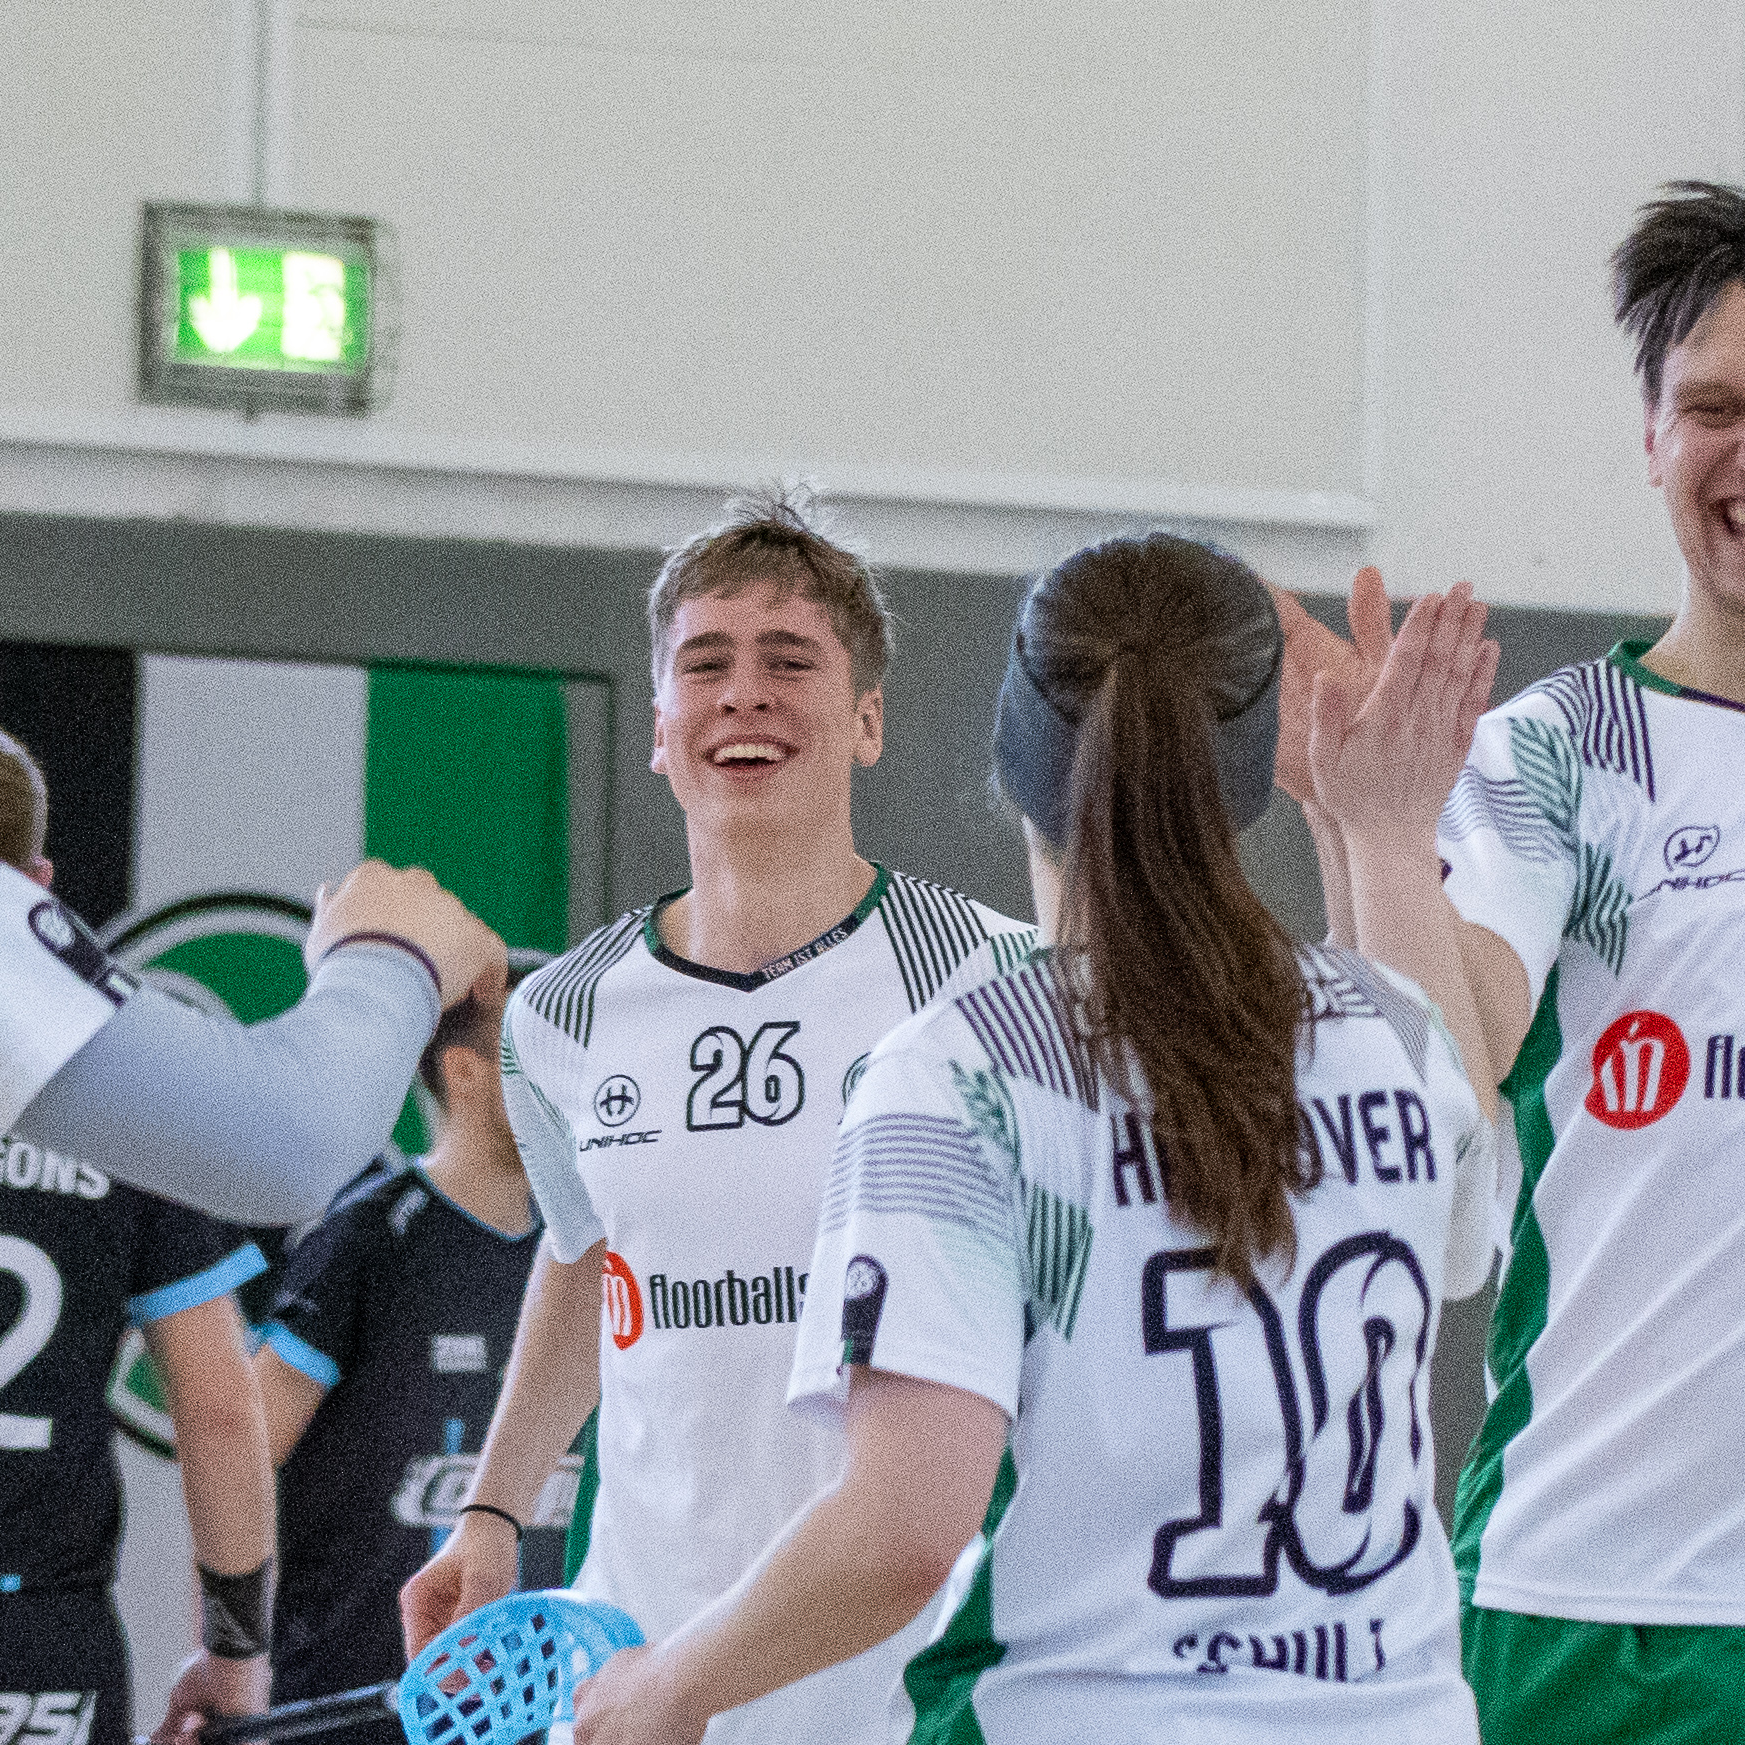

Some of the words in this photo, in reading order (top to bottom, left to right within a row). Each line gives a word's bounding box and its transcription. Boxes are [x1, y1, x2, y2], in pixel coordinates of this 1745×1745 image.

[687, 1021, 806, 1132] 26
[1110, 1088, 1437, 1207] HOVER
[1141, 1230, 1433, 1599] 10
